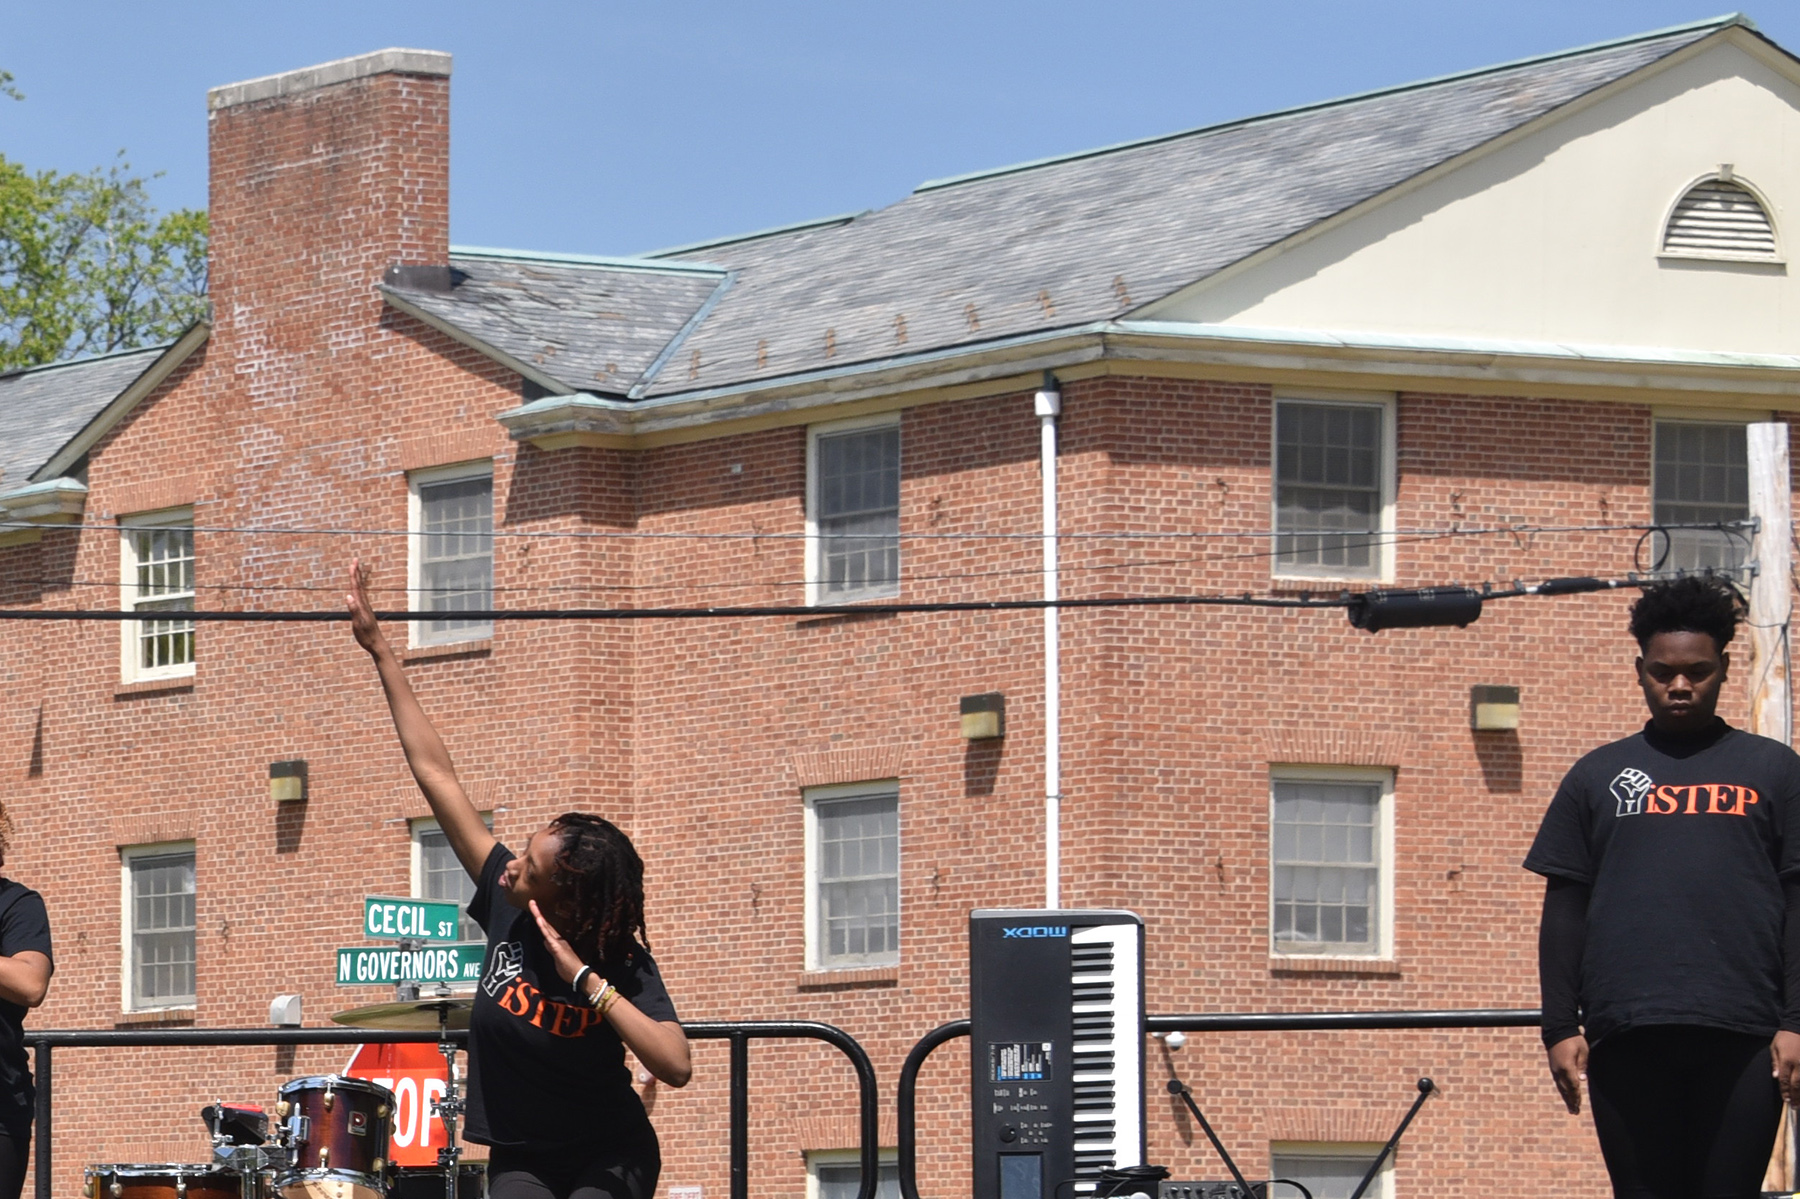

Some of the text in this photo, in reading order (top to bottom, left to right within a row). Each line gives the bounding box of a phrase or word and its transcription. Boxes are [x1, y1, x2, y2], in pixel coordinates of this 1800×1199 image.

[1644, 783, 1760, 817] iSTEP
[367, 903, 454, 938] CECIL ST
[1001, 925, 1068, 939] MODX
[339, 949, 482, 982] N GOVERNORS AVE
[497, 975, 603, 1039] iSTEP
